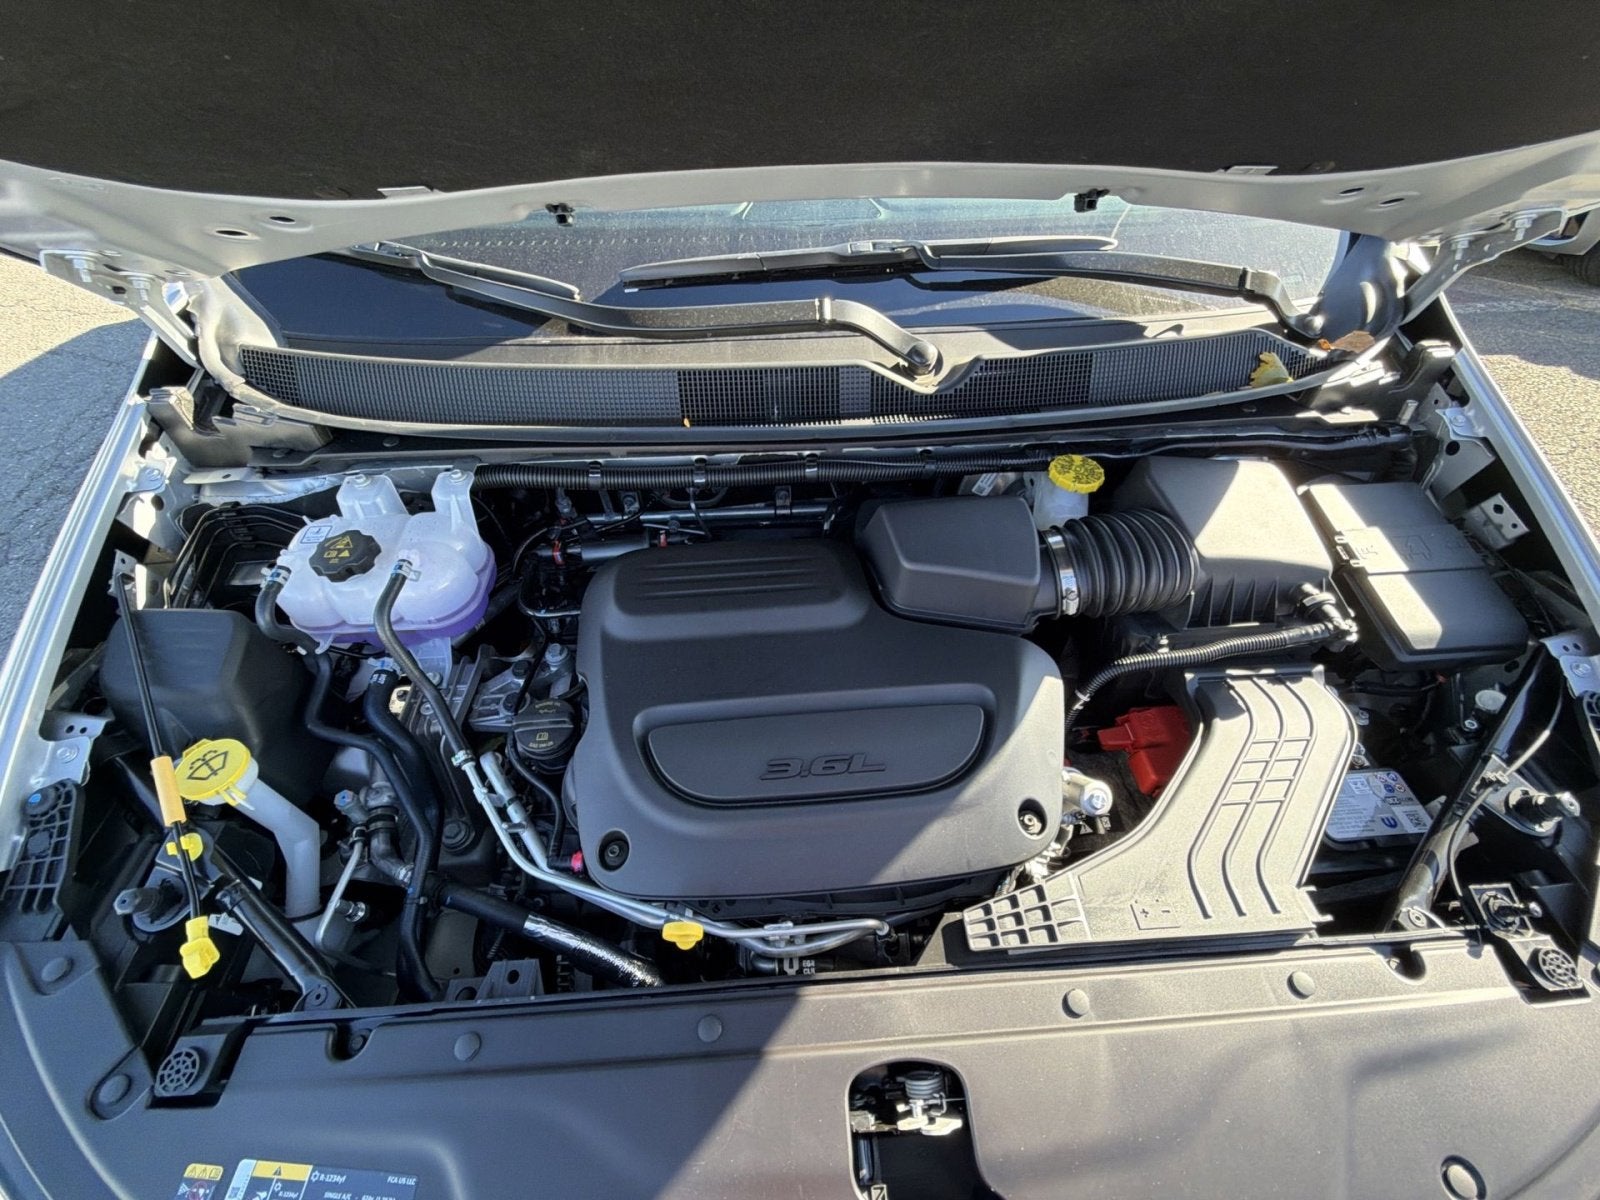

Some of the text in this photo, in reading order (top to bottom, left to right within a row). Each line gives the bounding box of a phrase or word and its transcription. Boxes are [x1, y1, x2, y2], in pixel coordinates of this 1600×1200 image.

[759, 752, 887, 781] 3.6L
[320, 1173, 347, 1185] R-1234yf
[387, 1175, 398, 1184] FCA
[406, 1178, 417, 1186] LLC
